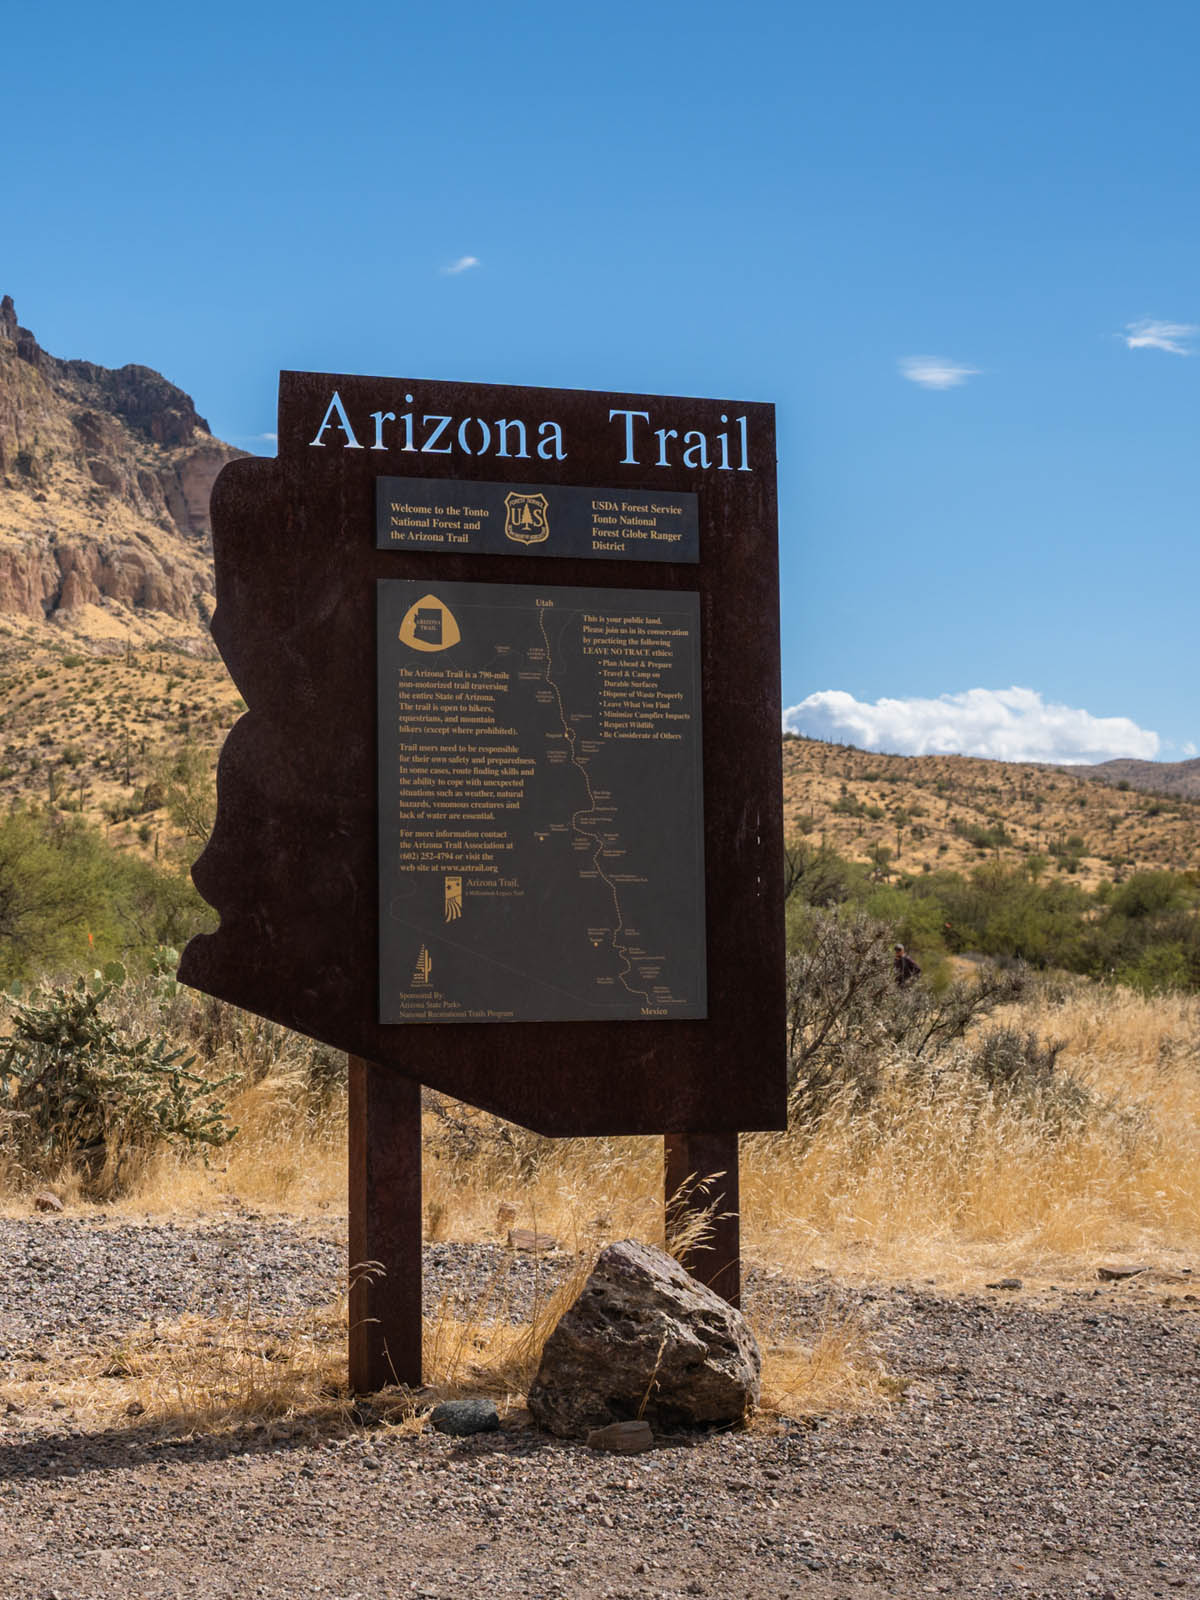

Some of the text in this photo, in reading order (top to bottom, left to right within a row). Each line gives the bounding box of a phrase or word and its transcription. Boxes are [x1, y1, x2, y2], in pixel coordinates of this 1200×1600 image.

[309, 391, 752, 471] Arizona Trail
[391, 503, 489, 516] Welcome to the Tonto
[592, 501, 682, 514] USDA Forest Service
[391, 517, 480, 530] National Forest and
[592, 514, 656, 526] Tonto National
[391, 530, 469, 543] the Arizona Trail
[592, 528, 682, 542] Forest Globe Ranger
[592, 541, 625, 551] District
[536, 599, 553, 607] Utah
[584, 625, 603, 633] Please
[584, 636, 590, 645] by
[641, 639, 670, 647] following
[603, 659, 617, 667] Plan
[648, 661, 672, 669] Prepare
[400, 669, 413, 677] The
[415, 669, 444, 677] Arizona
[447, 670, 463, 678] Trail
[399, 681, 452, 689] non-motorized
[471, 683, 507, 691] traversing
[400, 691, 410, 699] the
[416, 703, 431, 711] trail
[478, 746, 518, 754] responsible
[449, 755, 469, 764] safety
[474, 767, 498, 776] finding
[413, 778, 435, 786] ability
[484, 779, 523, 787] unexpected
[400, 788, 434, 796] situations
[400, 811, 416, 819] lack
[417, 811, 425, 819] of
[436, 830, 479, 838] information
[464, 841, 504, 849] Association
[467, 879, 497, 887] Arizona
